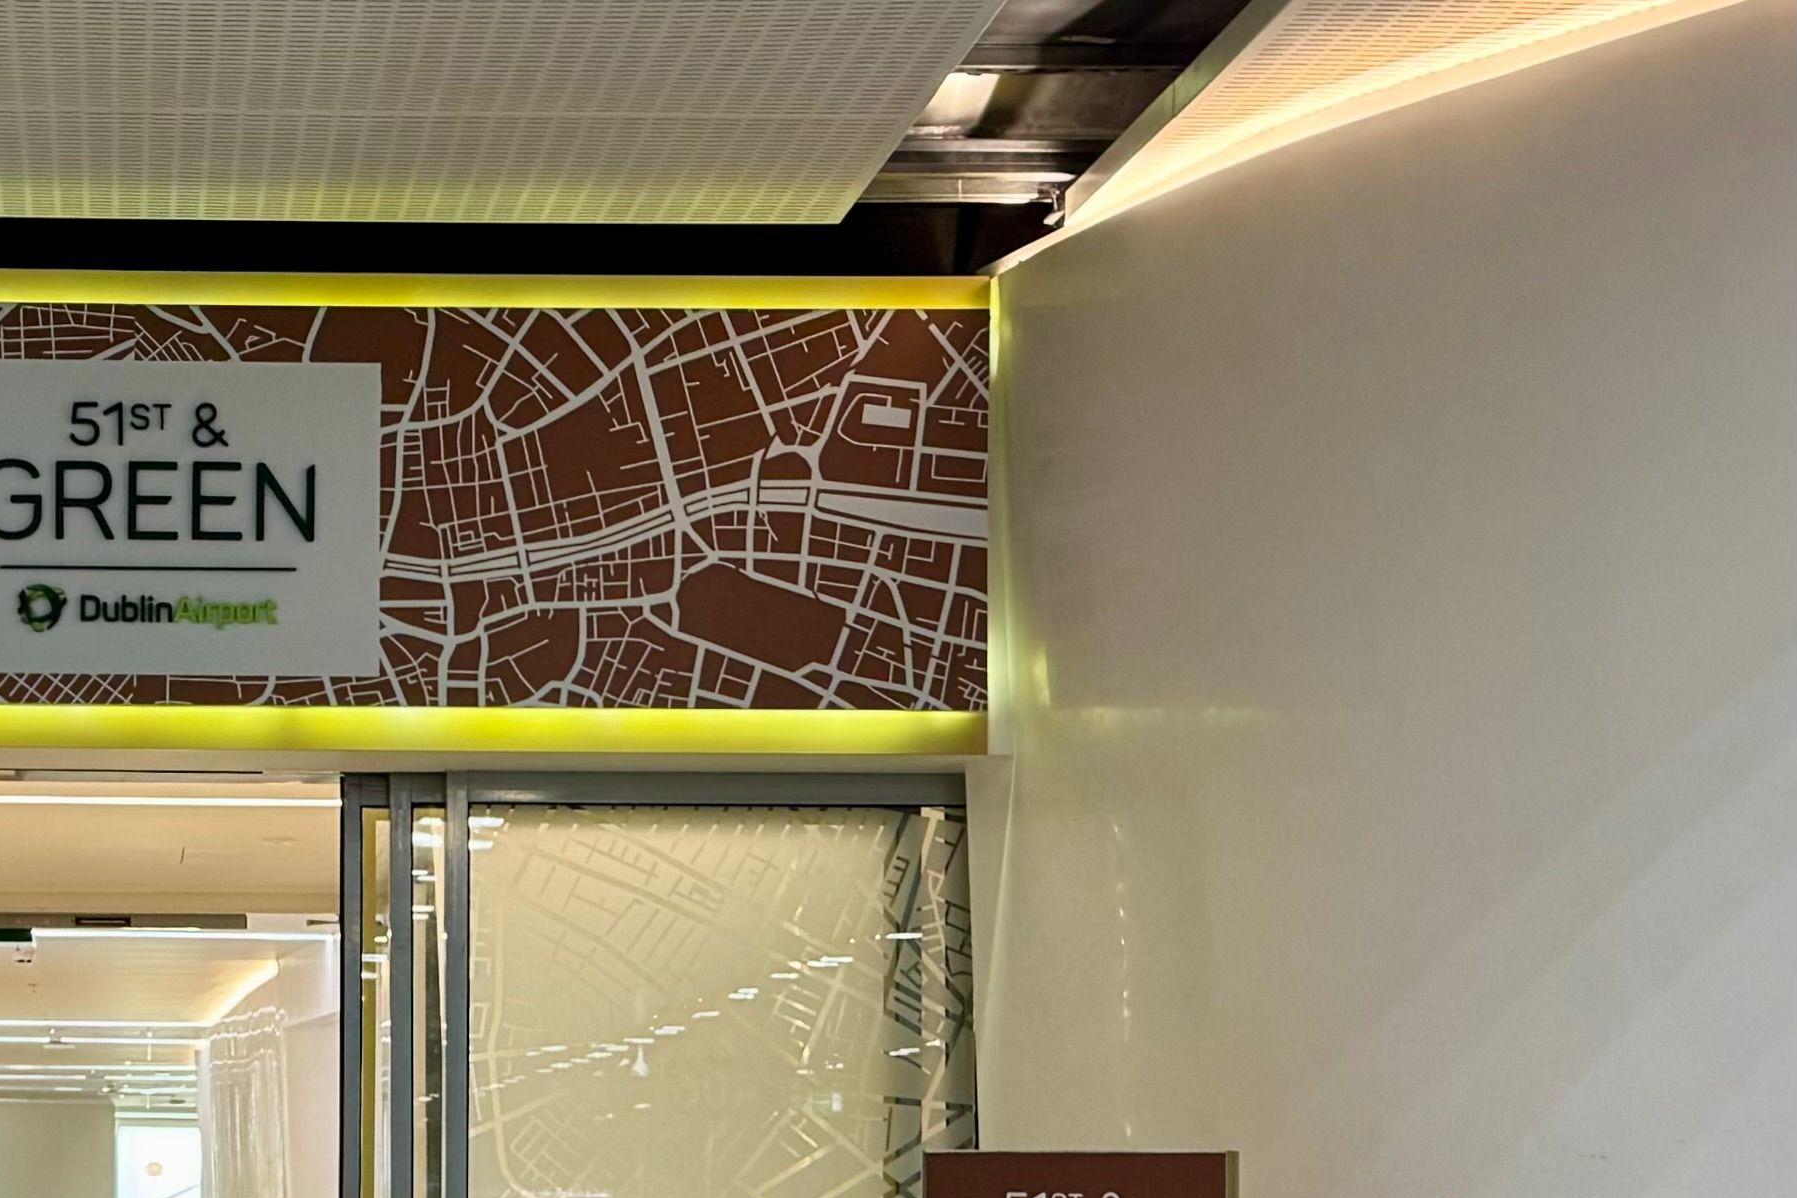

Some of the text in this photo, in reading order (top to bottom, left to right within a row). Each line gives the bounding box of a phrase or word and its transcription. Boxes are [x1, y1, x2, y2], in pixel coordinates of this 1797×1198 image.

[69, 401, 229, 447] 51ST &
[80, 594, 278, 630] DublinAirport
